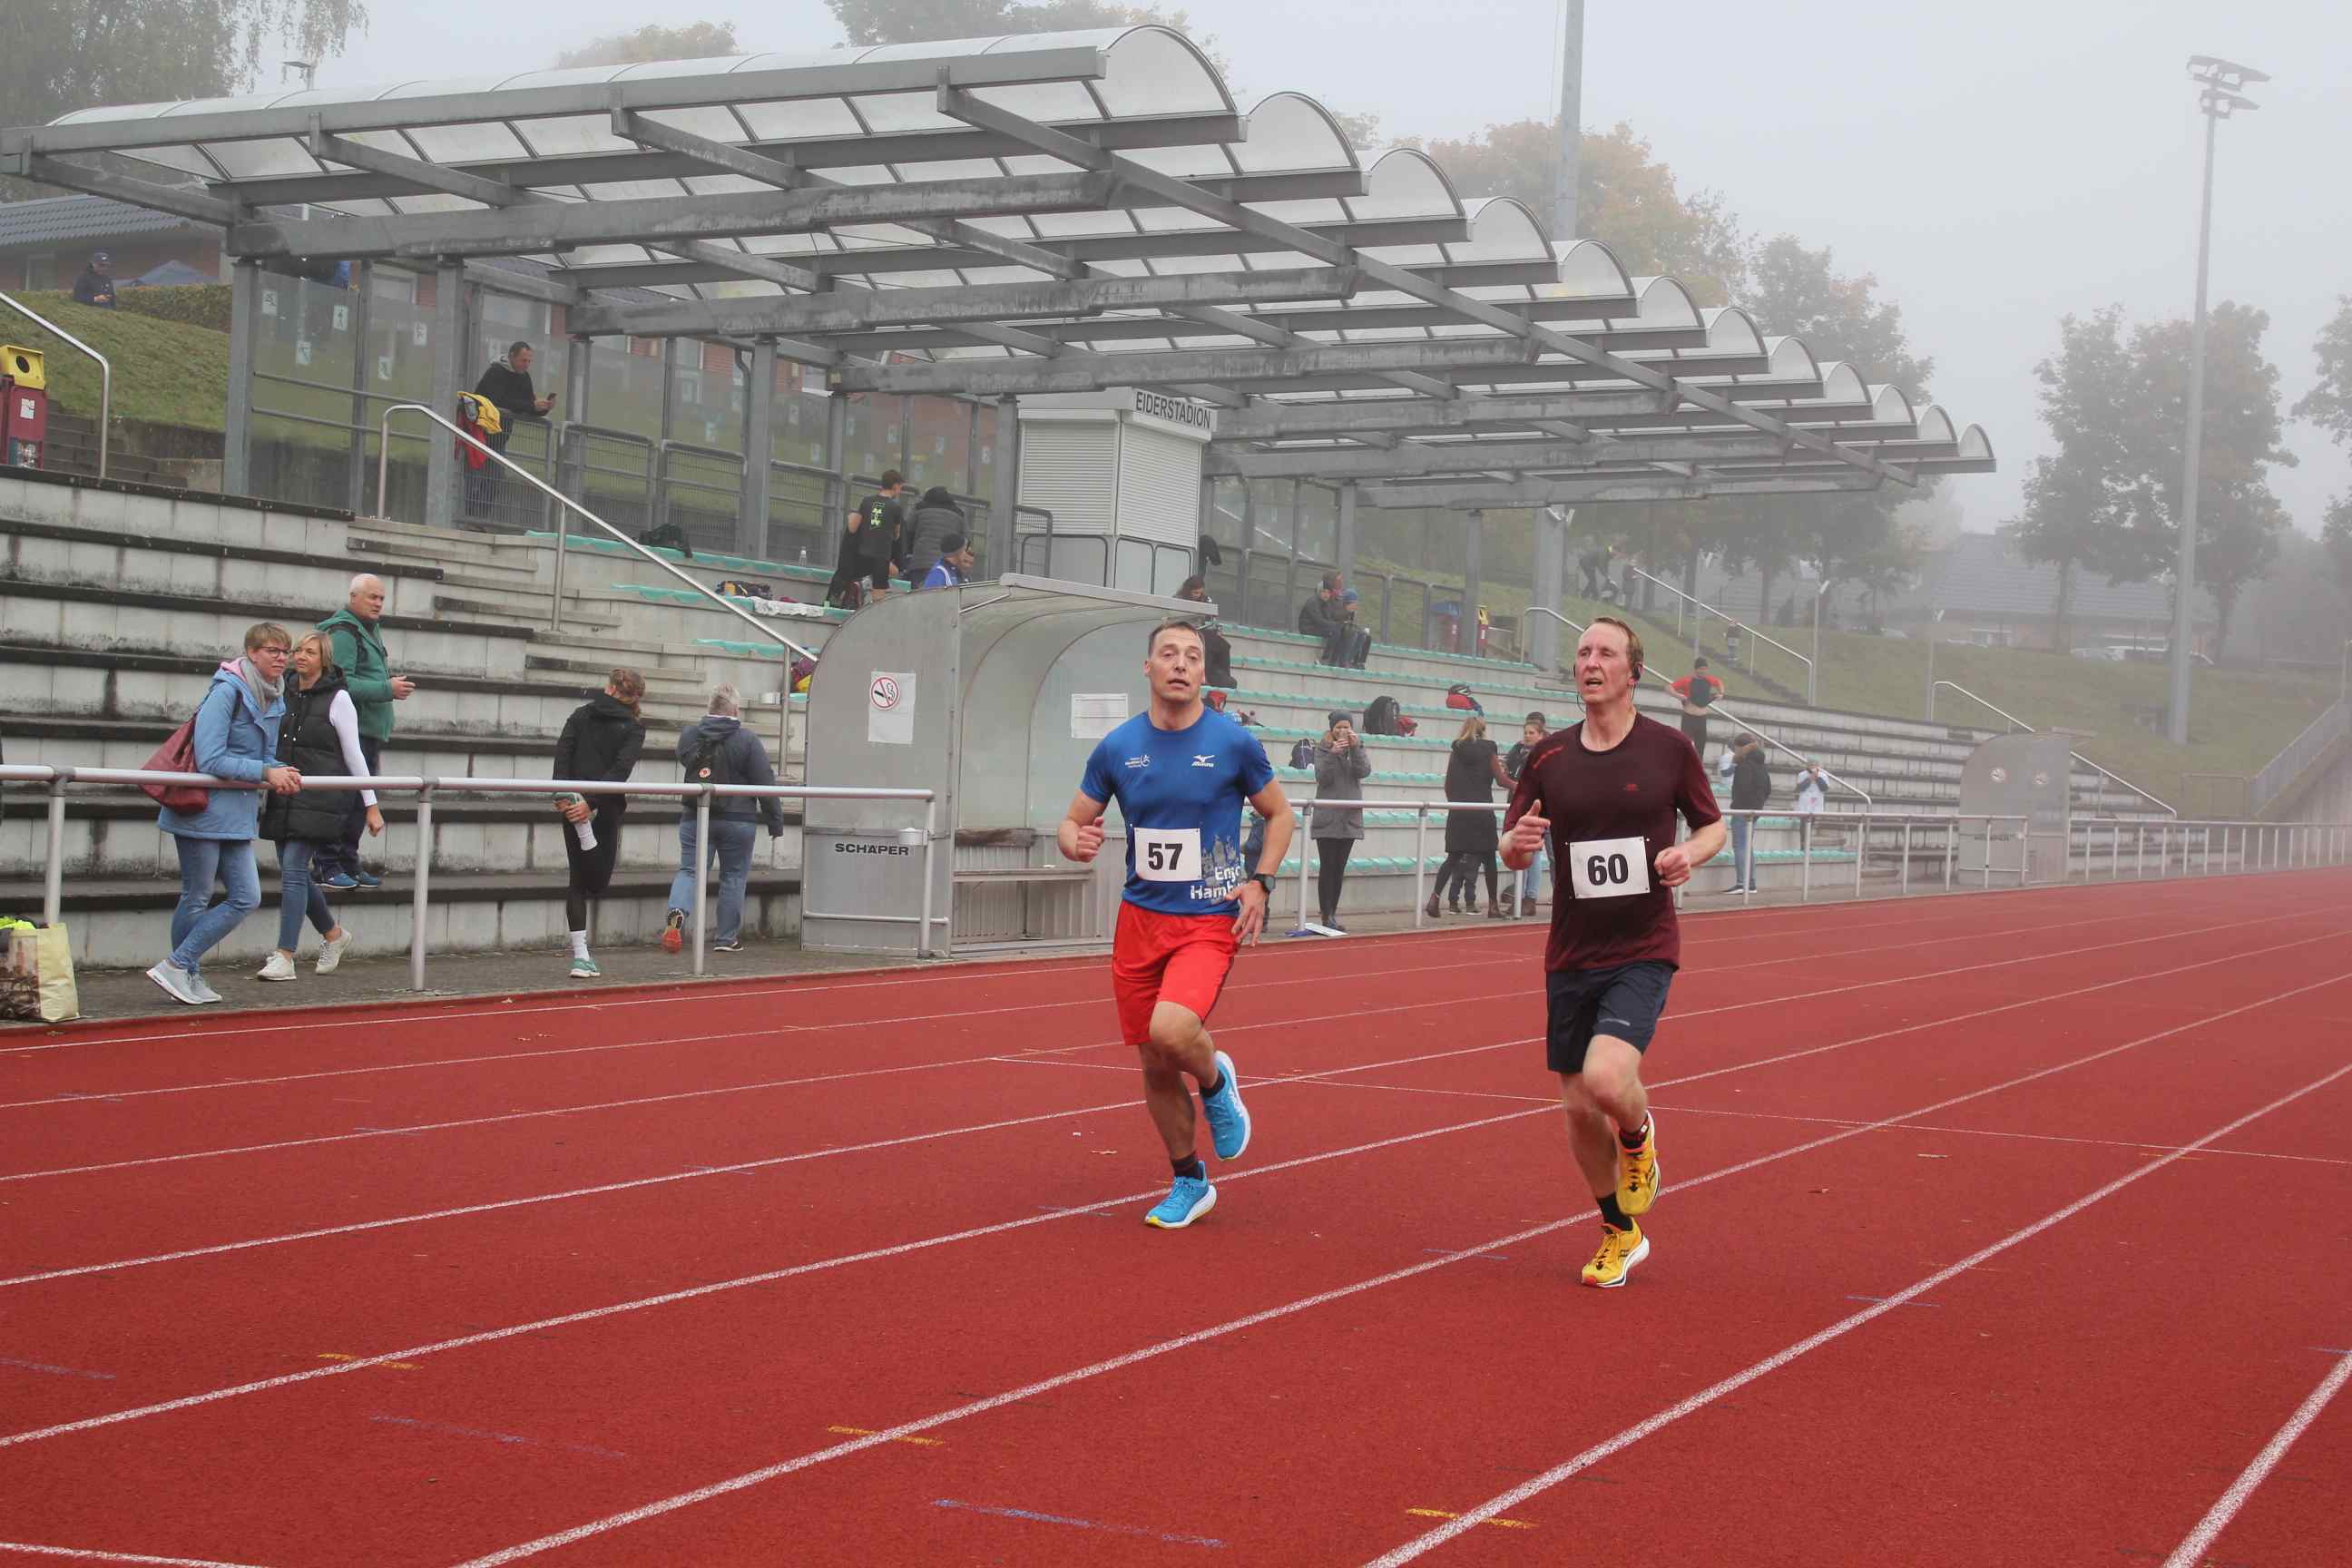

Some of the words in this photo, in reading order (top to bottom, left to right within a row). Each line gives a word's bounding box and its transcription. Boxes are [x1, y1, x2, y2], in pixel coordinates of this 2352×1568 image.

[1135, 391, 1210, 429] EIDERSTADION
[1148, 842, 1183, 871] 57
[1587, 853, 1629, 887] 60
